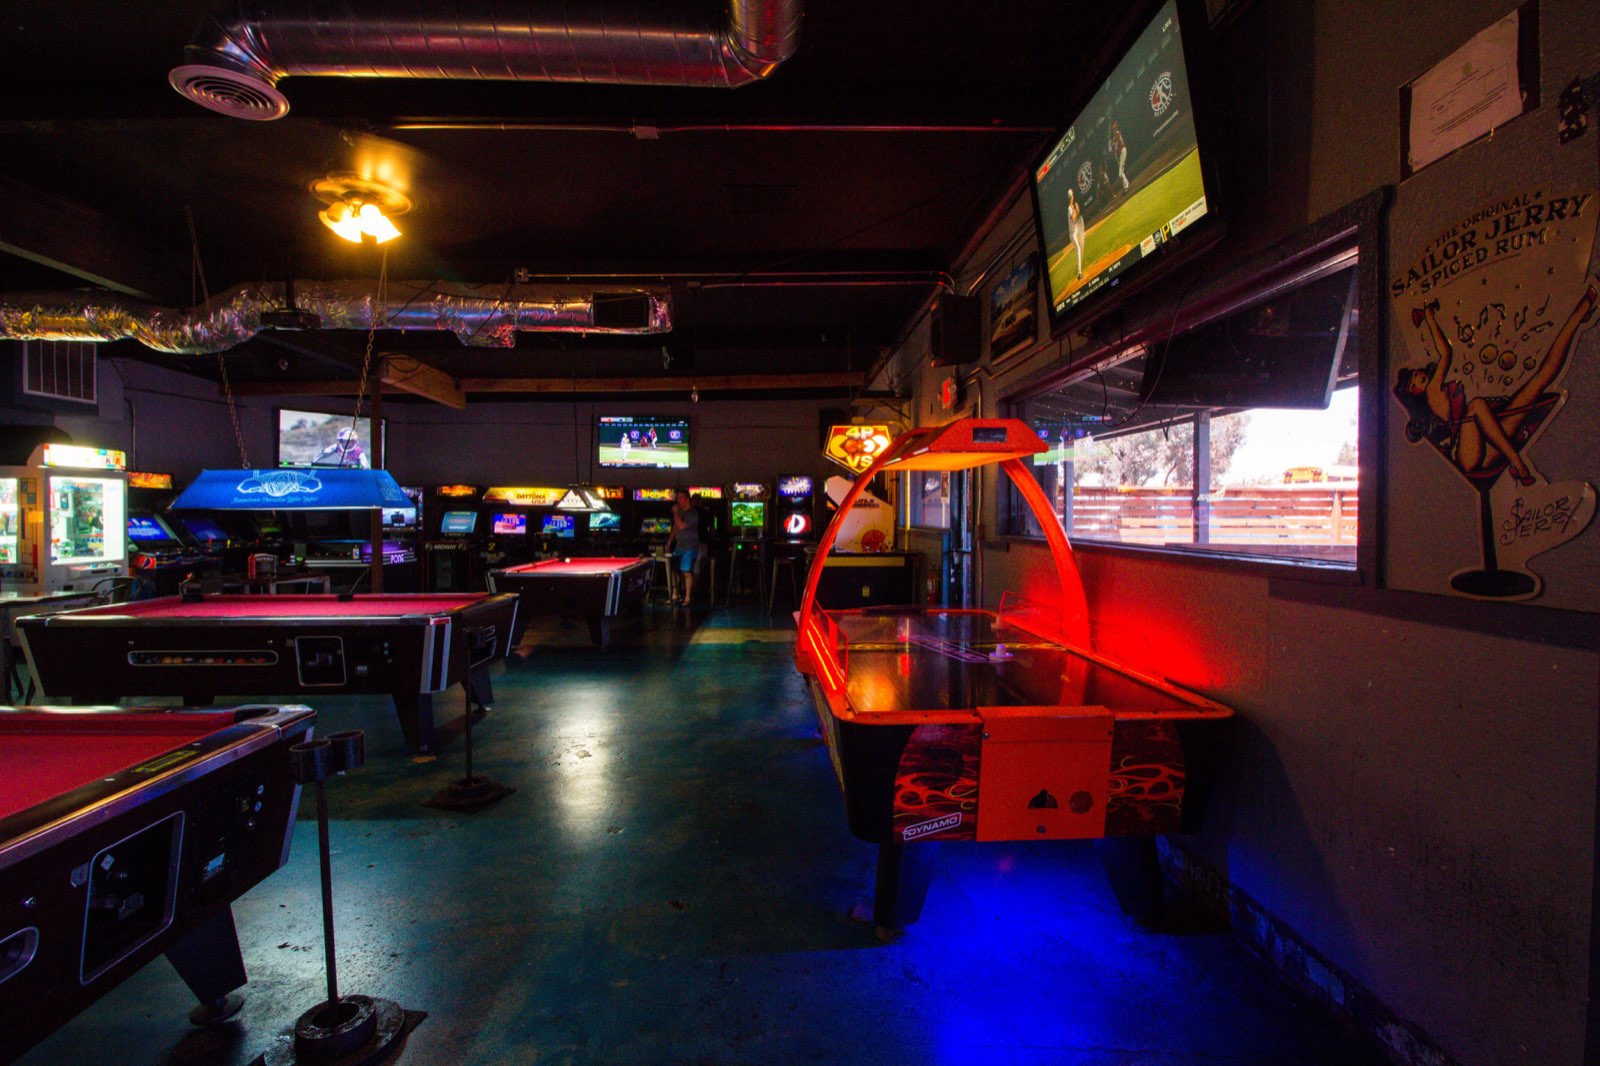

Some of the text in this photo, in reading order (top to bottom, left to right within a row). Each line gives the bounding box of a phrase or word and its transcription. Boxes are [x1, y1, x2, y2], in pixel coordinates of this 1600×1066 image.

[1435, 194, 1532, 249] THE ORIGINAL
[1392, 194, 1593, 299] SAILOR JERRY
[1420, 227, 1548, 294] SPICED RUM
[845, 426, 874, 440] 4P
[846, 455, 874, 467] VS
[1503, 496, 1571, 532] SAILOR
[434, 543, 457, 551] MIDWAY
[903, 816, 958, 836] DYNAMO
